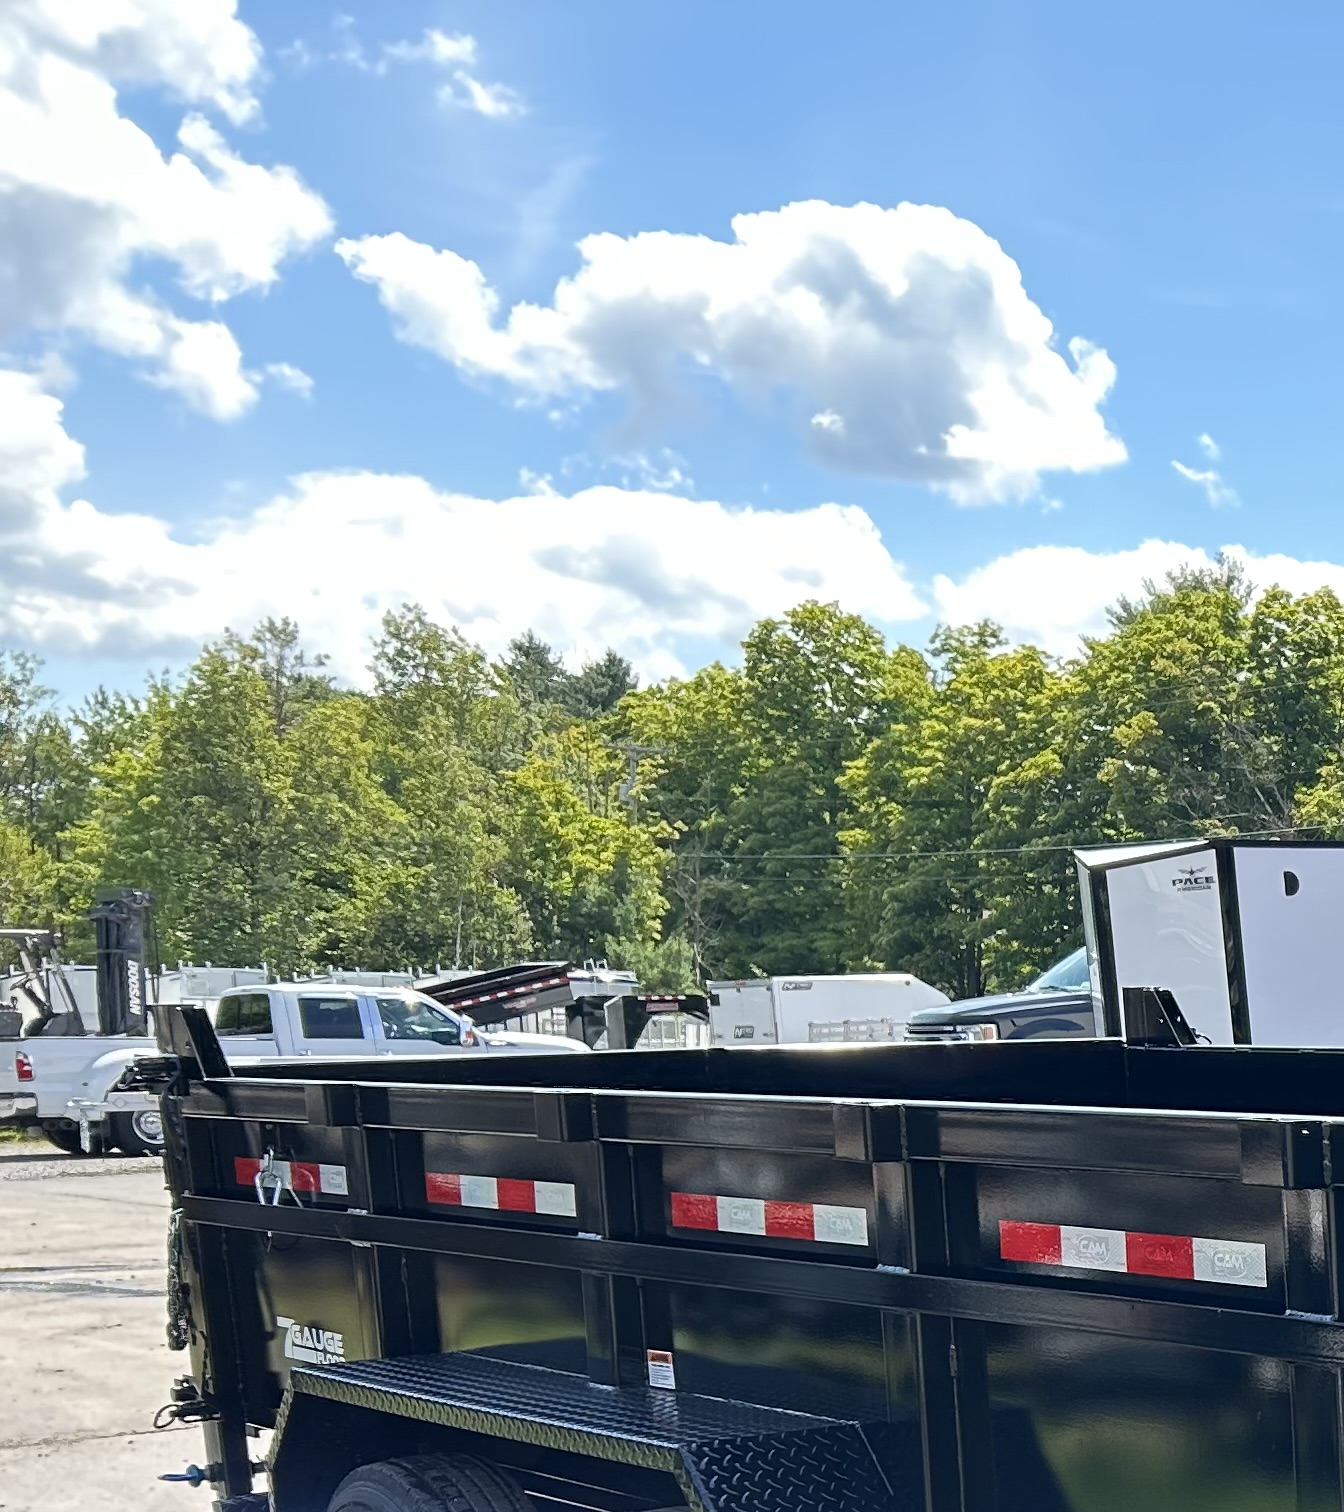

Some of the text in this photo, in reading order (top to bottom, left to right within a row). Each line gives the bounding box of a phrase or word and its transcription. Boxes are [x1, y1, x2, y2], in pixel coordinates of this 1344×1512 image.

[1172, 876, 1216, 886] PACE
[127, 960, 142, 1015] DOOSAN
[1080, 1240, 1106, 1256] CAM
[1214, 1253, 1245, 1270] CAM
[276, 1315, 345, 1359] 7 GAUGE
